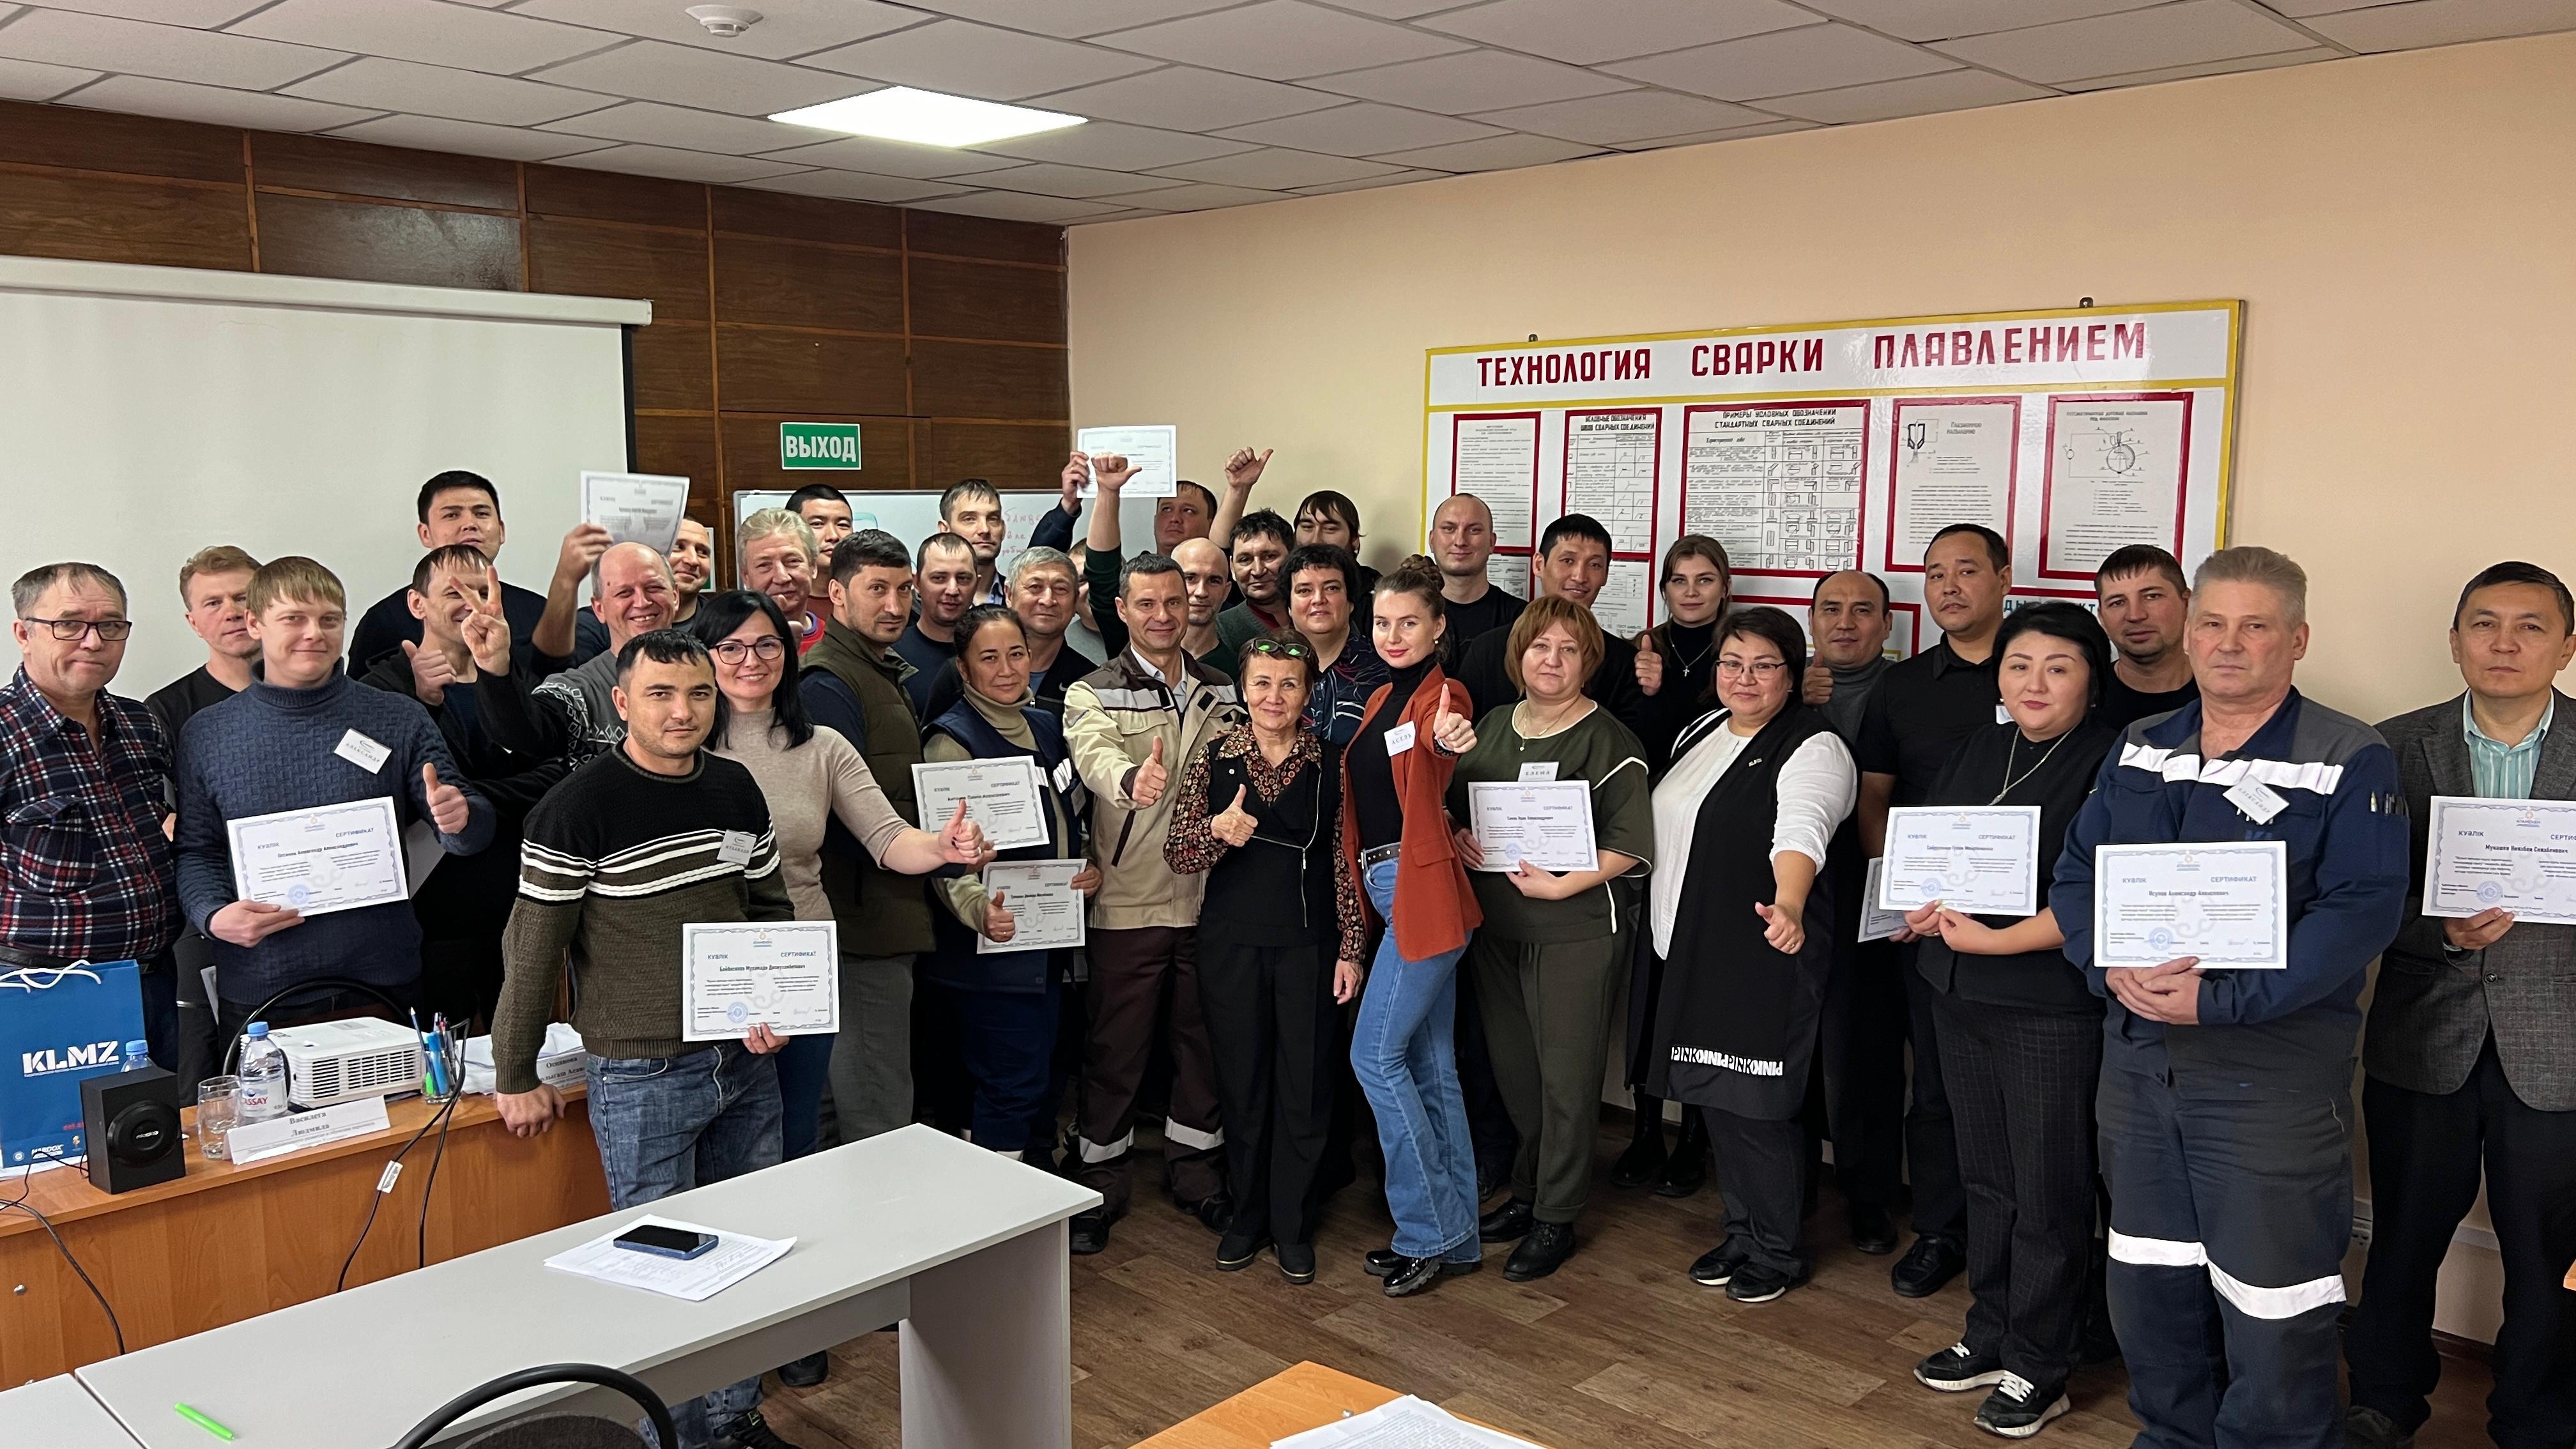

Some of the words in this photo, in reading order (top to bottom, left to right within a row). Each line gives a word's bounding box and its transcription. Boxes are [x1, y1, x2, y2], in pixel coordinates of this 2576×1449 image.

[1477, 349, 1651, 387] ТЕХНОЛОГИЯ
[1692, 339, 1823, 377] СВАРКИ
[1874, 323, 2145, 369] ПЛАВЛЕНИЕМ
[1723, 410, 1752, 418] ПРИМЕРЫ
[1756, 409, 1789, 417] УСЛОВНЫХ
[1715, 419, 1758, 429] СТАНДАРТНЫХ
[1762, 419, 1791, 427] СВАРНЫХ
[1794, 417, 1835, 426] СОЕДИНЕНИЙ
[785, 435, 857, 463] ВЫХОД
[1392, 733, 1413, 746] АСЕЛЬ
[346, 742, 380, 763] АЛЕКСАНДР
[22, 1041, 119, 1074] KLMZ
[245, 1096, 268, 1105] ASSAY
[291, 1123, 330, 1137] Людмила
